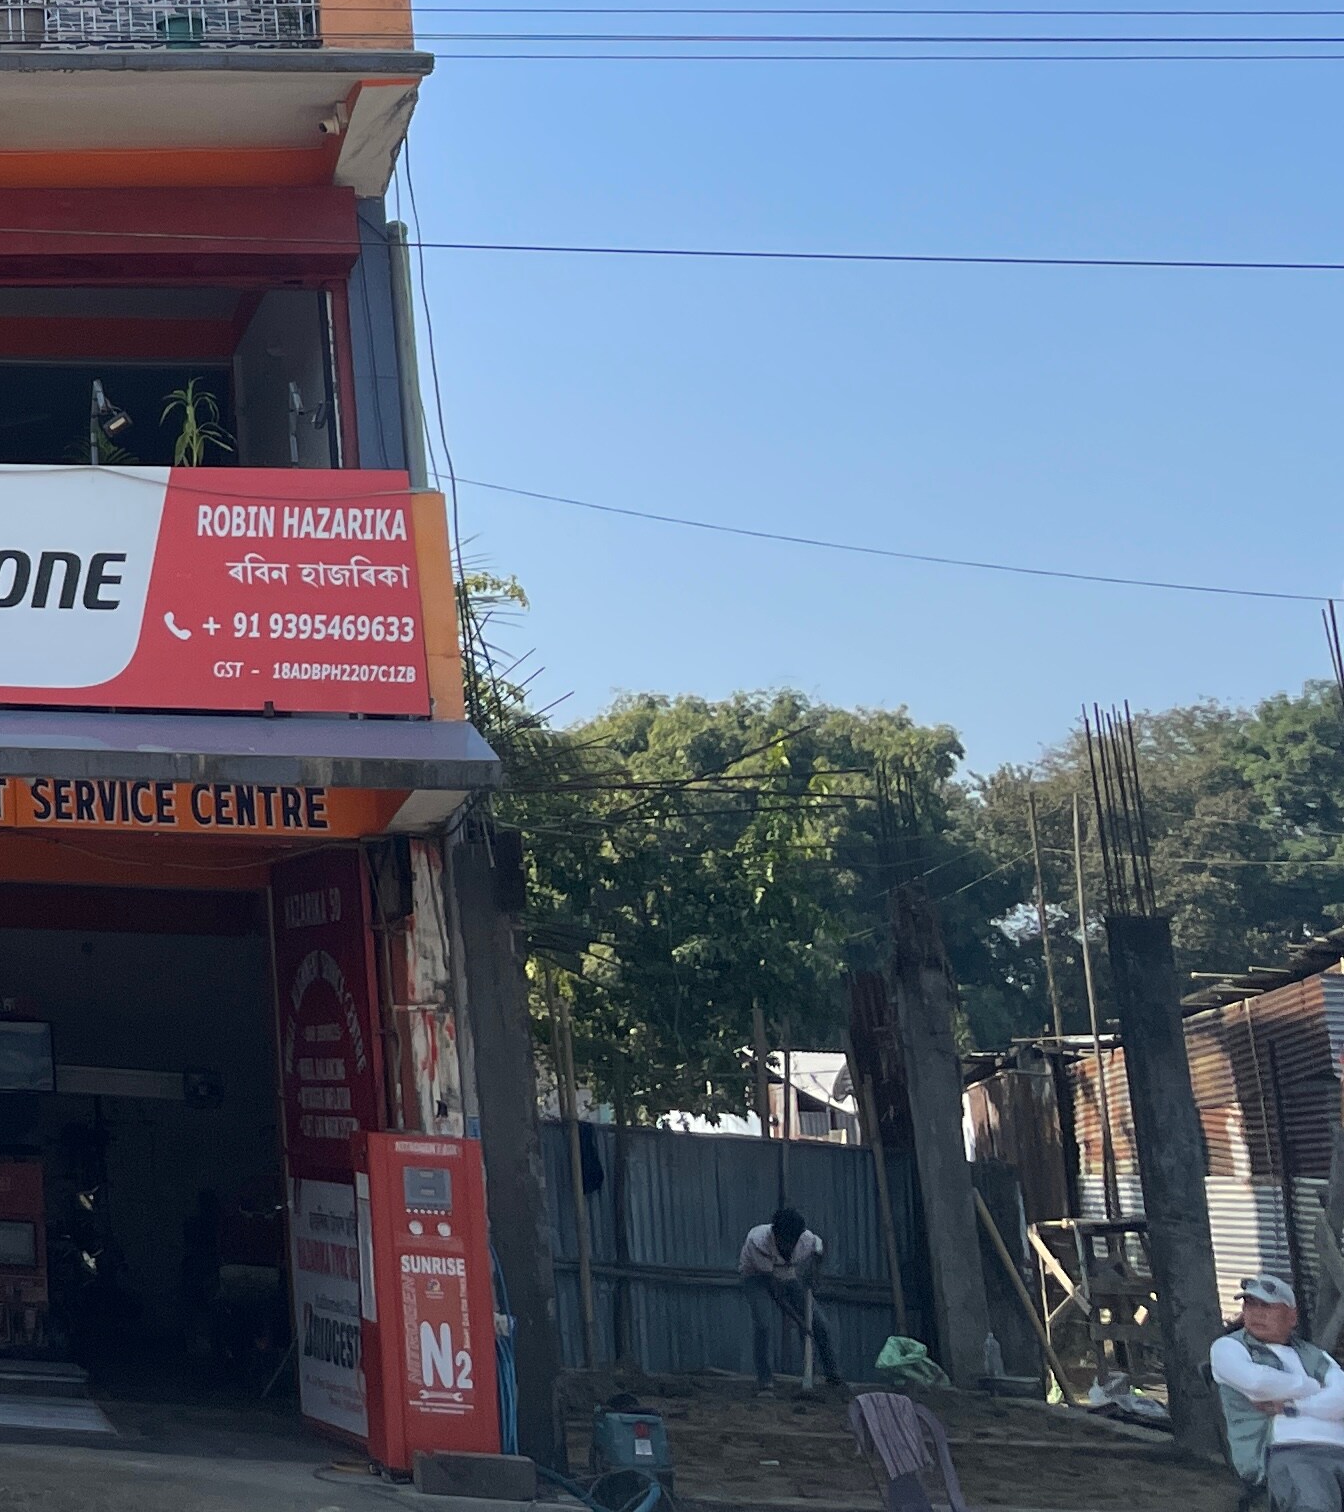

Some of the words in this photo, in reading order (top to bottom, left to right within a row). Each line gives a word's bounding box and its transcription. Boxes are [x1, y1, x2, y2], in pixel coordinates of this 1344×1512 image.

[197, 505, 275, 538] ROBIN
[283, 506, 407, 541] HAZARIKA
[202, 616, 221, 636] +
[233, 612, 260, 638] 91
[269, 614, 415, 643] 9395469633
[214, 661, 244, 678] GST
[32, 778, 178, 825] SERVICE
[190, 783, 330, 830] CENTRE
[400, 1254, 465, 1276] SUNRISE
